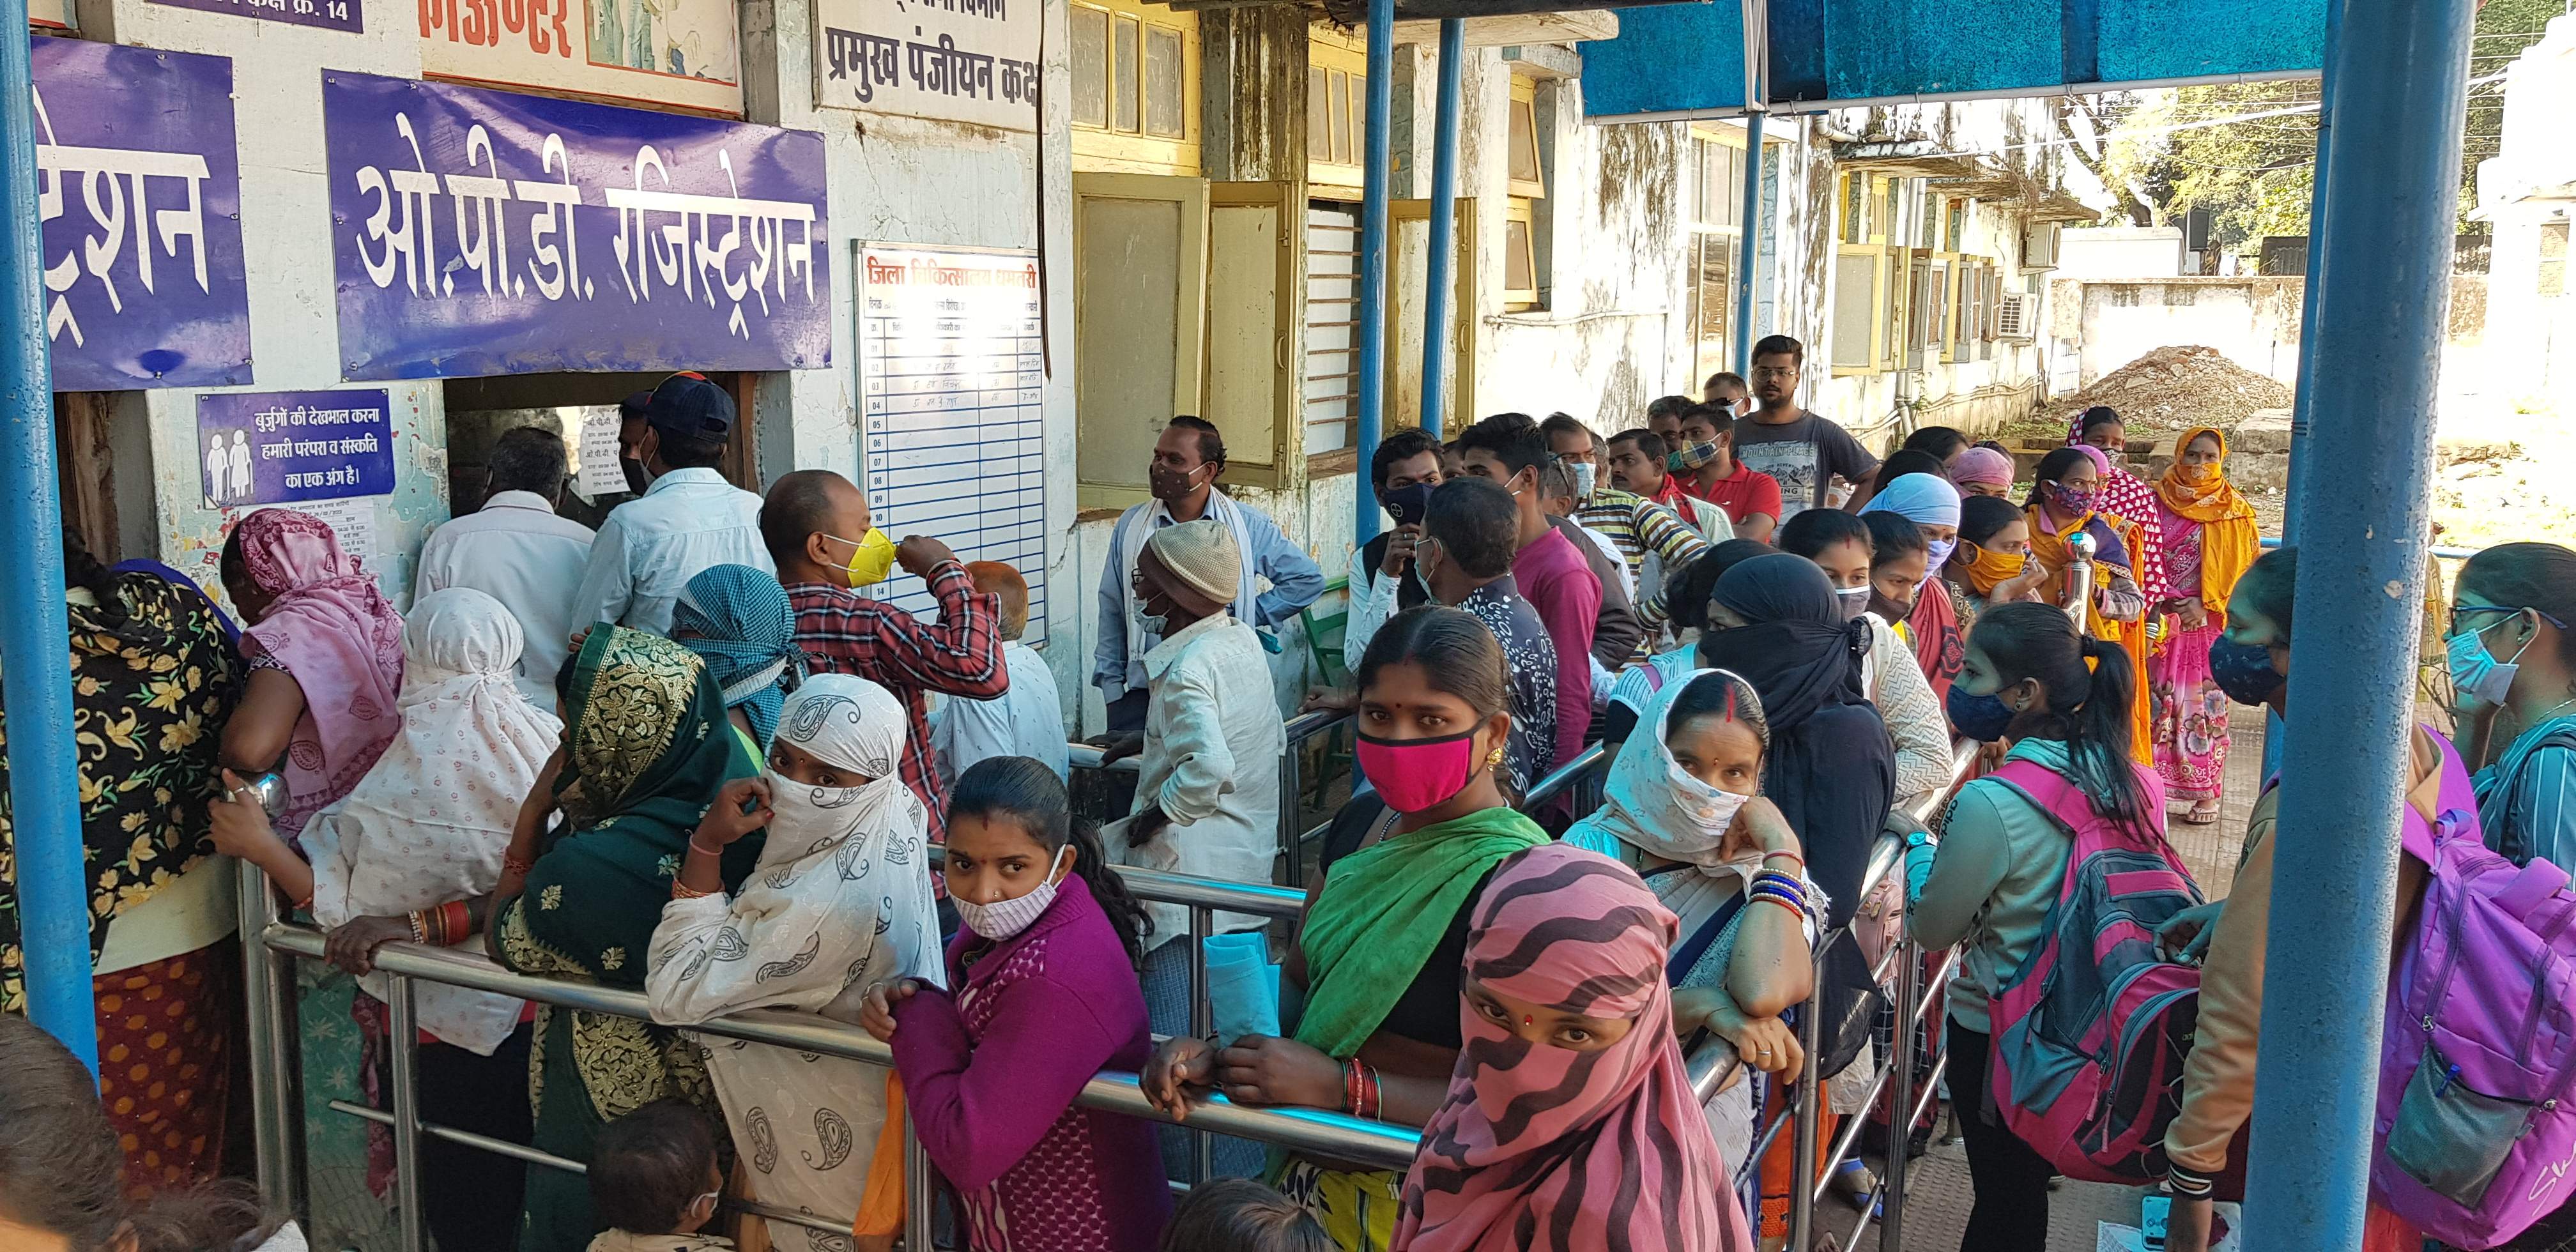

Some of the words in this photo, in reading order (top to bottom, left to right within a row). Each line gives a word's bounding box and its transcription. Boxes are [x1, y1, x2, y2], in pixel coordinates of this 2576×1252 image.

[326, 1, 348, 20] 14
[825, 26, 900, 103] प्रमुख
[906, 26, 994, 101] पंजीयन
[1000, 57, 1044, 107] कक्ष
[356, 112, 595, 302] ओ.पी.डी.
[604, 144, 816, 341] रजिस्ट्रेशन
[866, 256, 905, 285] जिला
[289, 406, 307, 426] की
[309, 406, 349, 426] देखभाल
[351, 408, 379, 424] करना
[261, 438, 293, 460] हमारी
[295, 439, 326, 457] परंपरा
[328, 441, 338, 455] व
[1742, 447, 1784, 458] MOUNTAIN
[874, 458, 881, 466] 07
[285, 473, 302, 488] का
[303, 471, 323, 487] एक
[325, 468, 344, 485] अंग
[874, 477, 882, 485] 08
[877, 588, 884, 596] 14
[1936, 799, 1958, 851] adid
